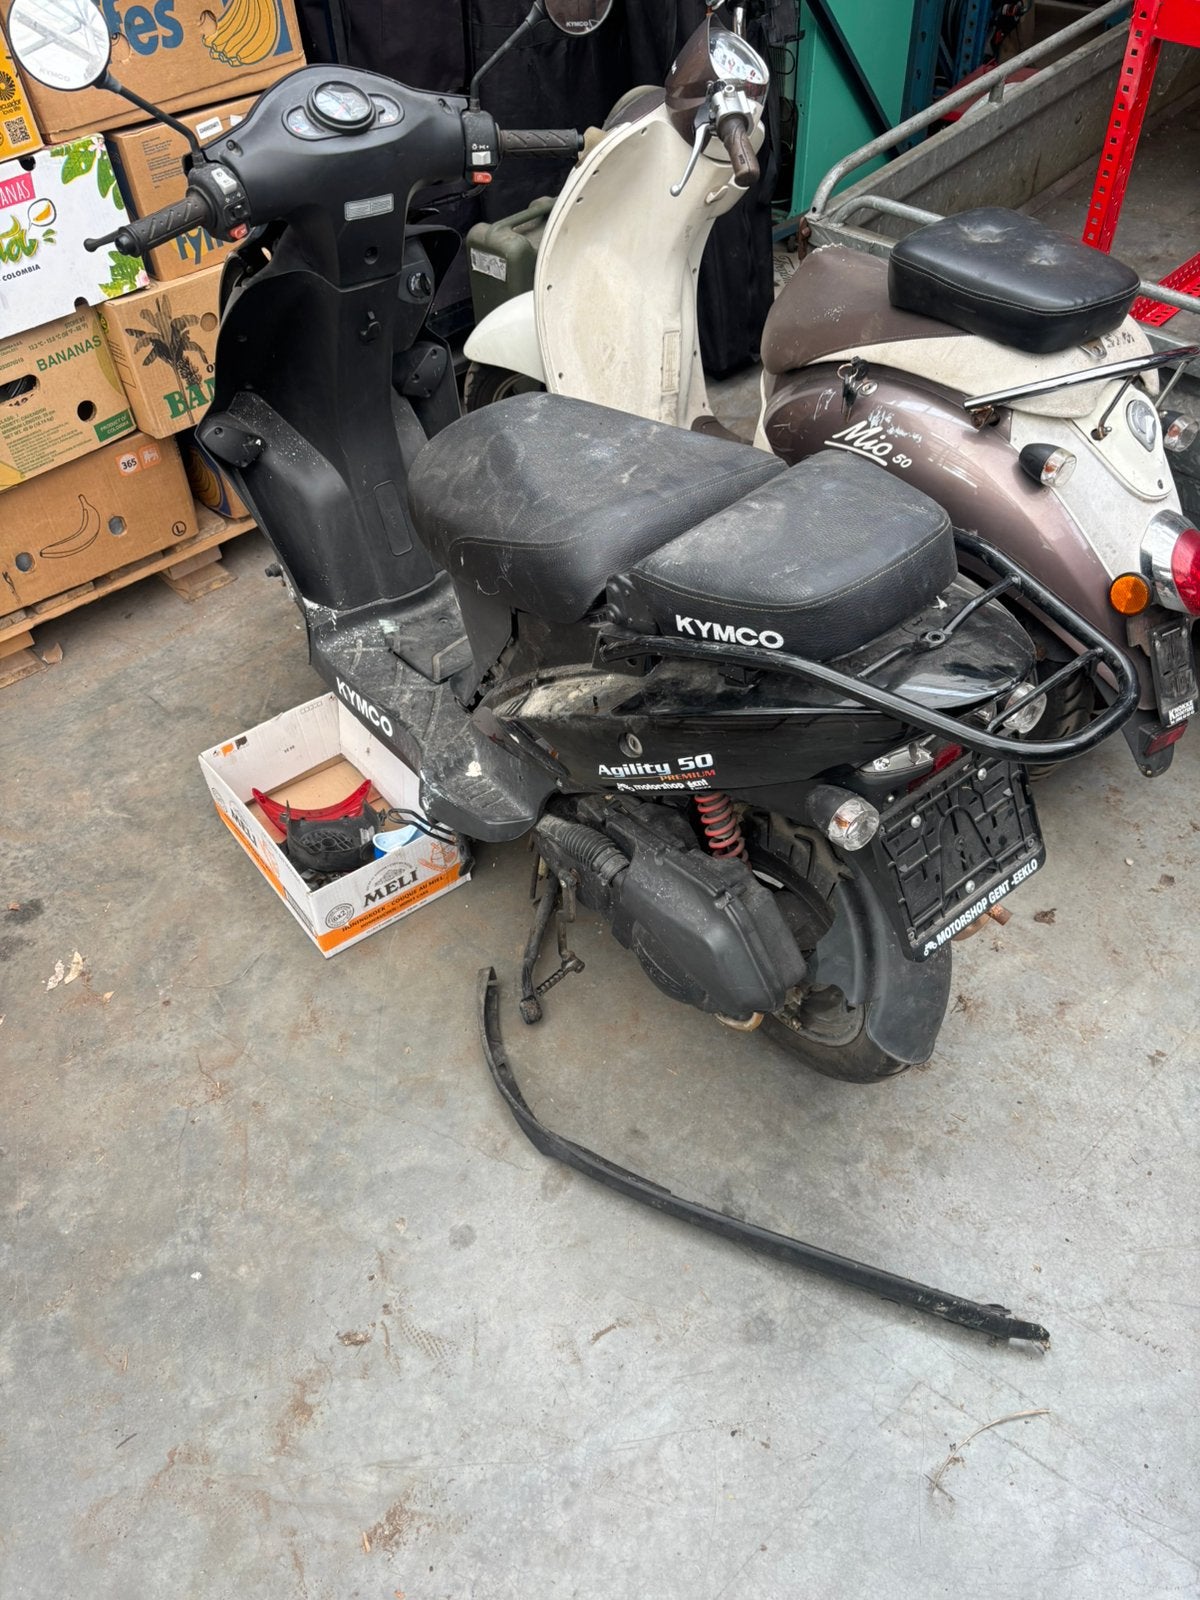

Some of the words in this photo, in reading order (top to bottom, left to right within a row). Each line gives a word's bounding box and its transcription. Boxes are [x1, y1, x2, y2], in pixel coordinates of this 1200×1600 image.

[2, 264, 41, 281] COLOMBIA
[36, 335, 103, 372] BANANAS
[832, 420, 873, 456] Mio
[892, 453, 912, 468] 50
[121, 458, 137, 470] 365
[676, 614, 784, 649] KYMCO
[336, 677, 393, 737] KYMCO
[598, 763, 671, 778] Agility
[677, 753, 714, 770] 50
[660, 769, 716, 781] PREMIUM
[634, 782, 685, 791] motorshop
[363, 869, 418, 908] MELI
[936, 896, 988, 946] MOTORSHOP
[988, 880, 1011, 904] GENT
